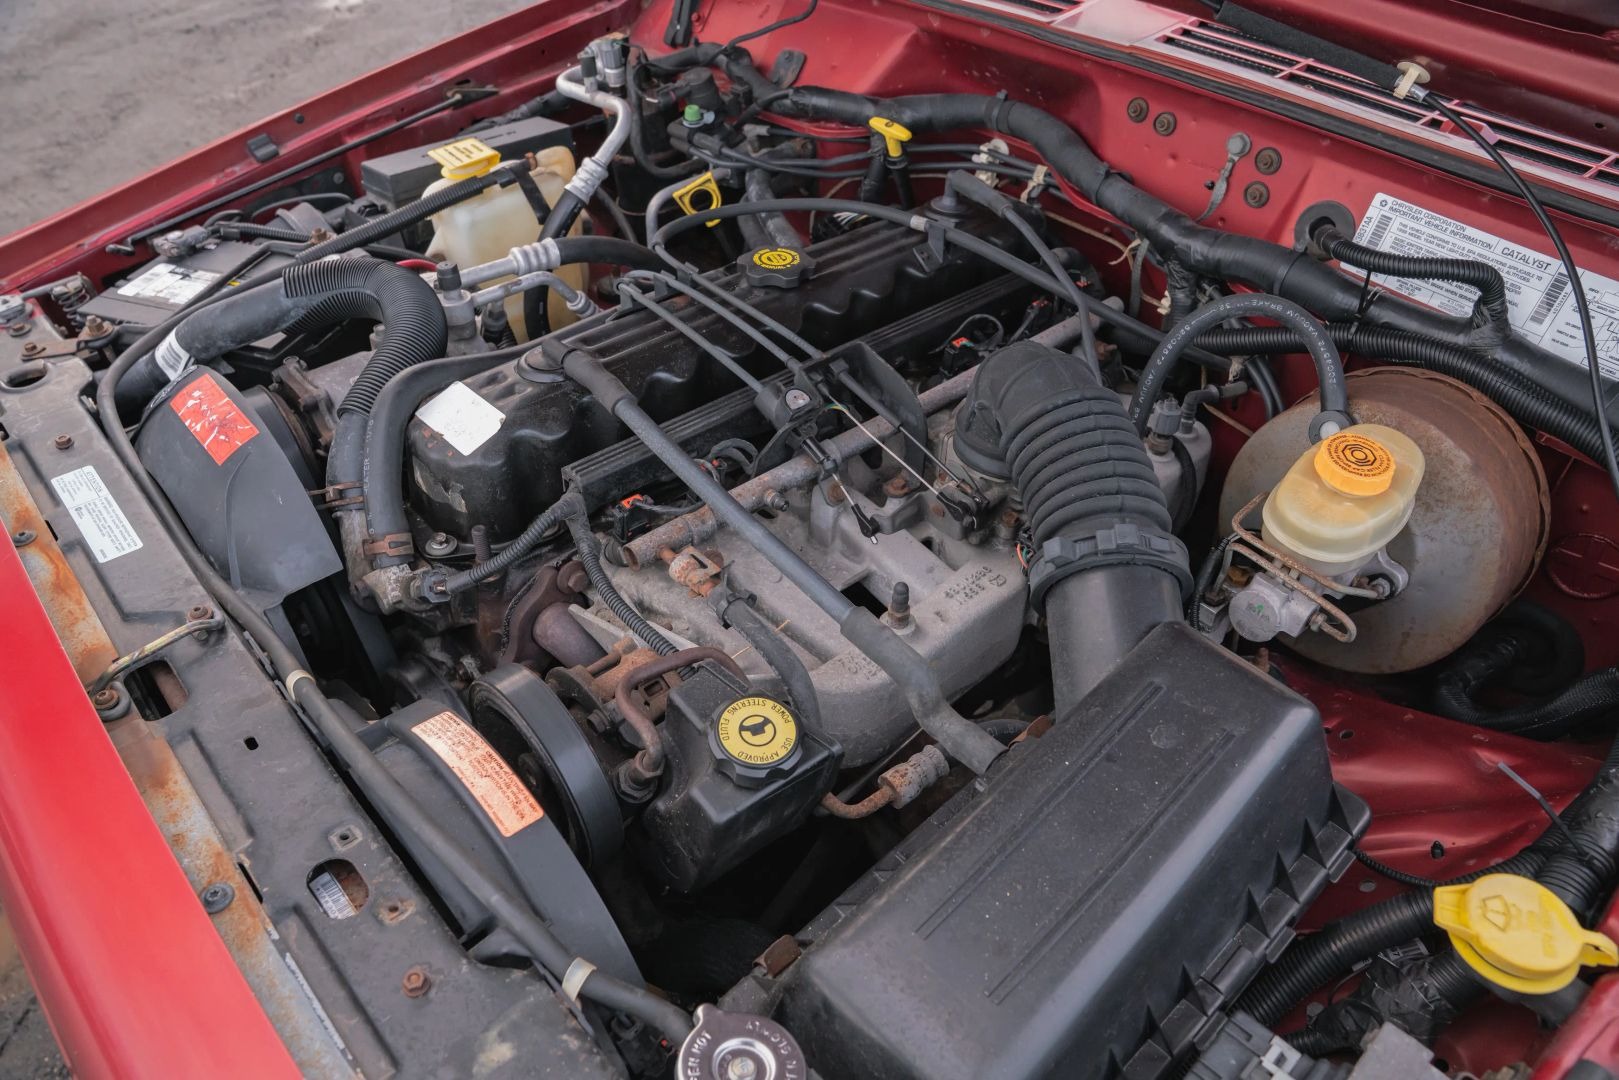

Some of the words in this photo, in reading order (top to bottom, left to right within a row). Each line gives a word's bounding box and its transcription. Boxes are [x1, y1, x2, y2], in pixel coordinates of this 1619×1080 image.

[1387, 205, 1424, 223] IMPORTANT
[1423, 219, 1449, 233] VEHICLE
[1448, 229, 1493, 250] INFORMATION
[1390, 200, 1423, 216] CHRYSLER
[1422, 212, 1466, 232] CORPORATION
[1425, 232, 1450, 244] CONFORMS
[1476, 252, 1507, 267] REGULATIONS
[1506, 264, 1535, 278] APPLICABLE
[1500, 246, 1551, 271] CATALYST
[1252, 300, 1282, 312] BRAKE
[1286, 310, 1318, 338] VACUUM
[728, 699, 768, 716] STEERING
[770, 704, 792, 724] POWER
[720, 718, 730, 741] FLUID
[781, 737, 793, 751] USE
[738, 750, 779, 762] APPROVED
[692, 1030, 712, 1054] HOT
